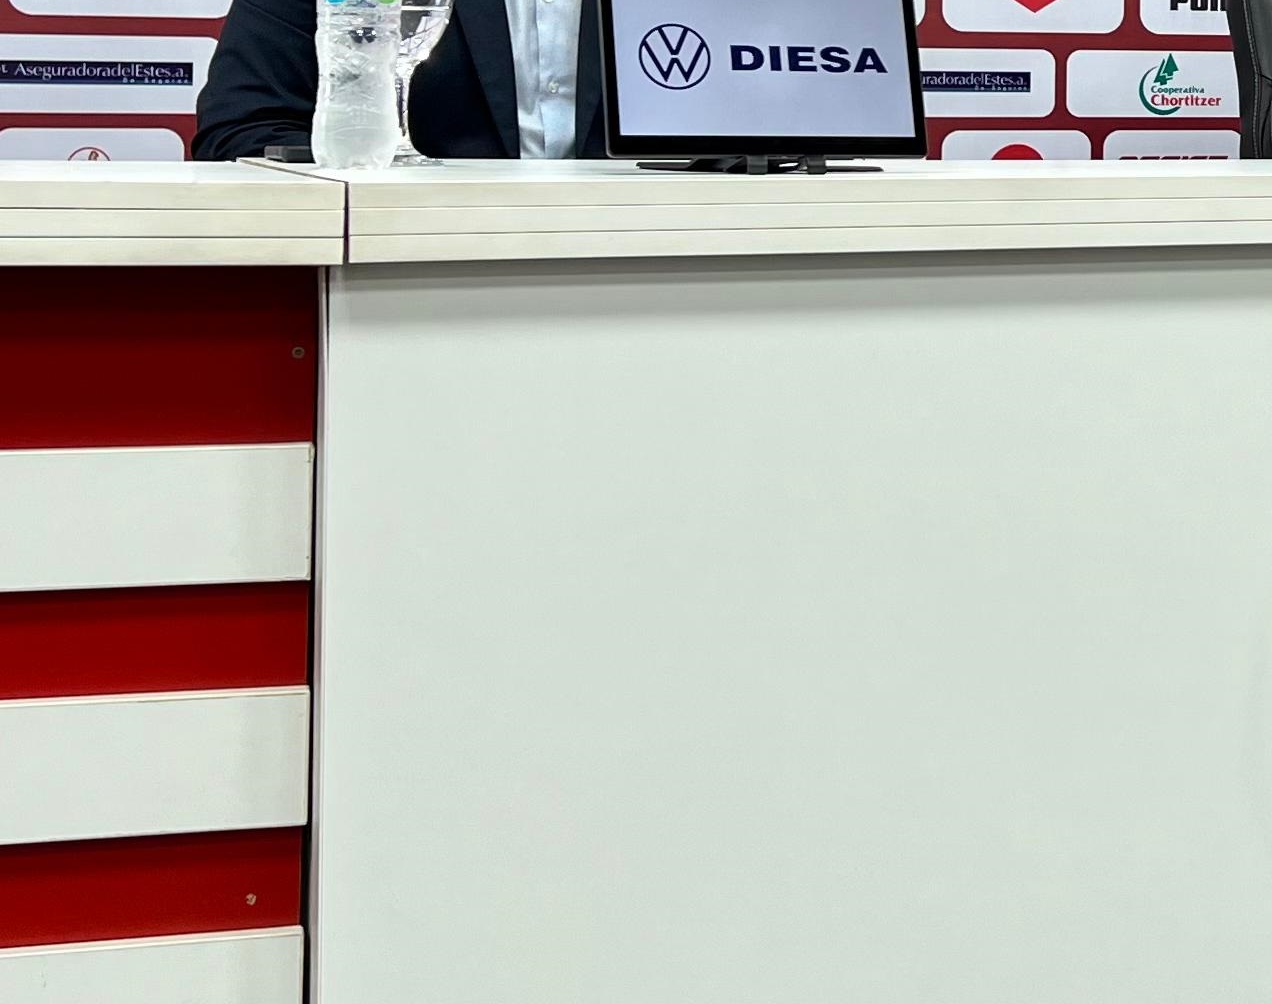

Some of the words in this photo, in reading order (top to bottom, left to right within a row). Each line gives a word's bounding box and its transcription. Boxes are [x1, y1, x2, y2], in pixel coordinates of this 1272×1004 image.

[730, 45, 888, 73] DIESA
[1150, 84, 1205, 96] Cooperativa
[1150, 94, 1222, 107] Chortitzer
